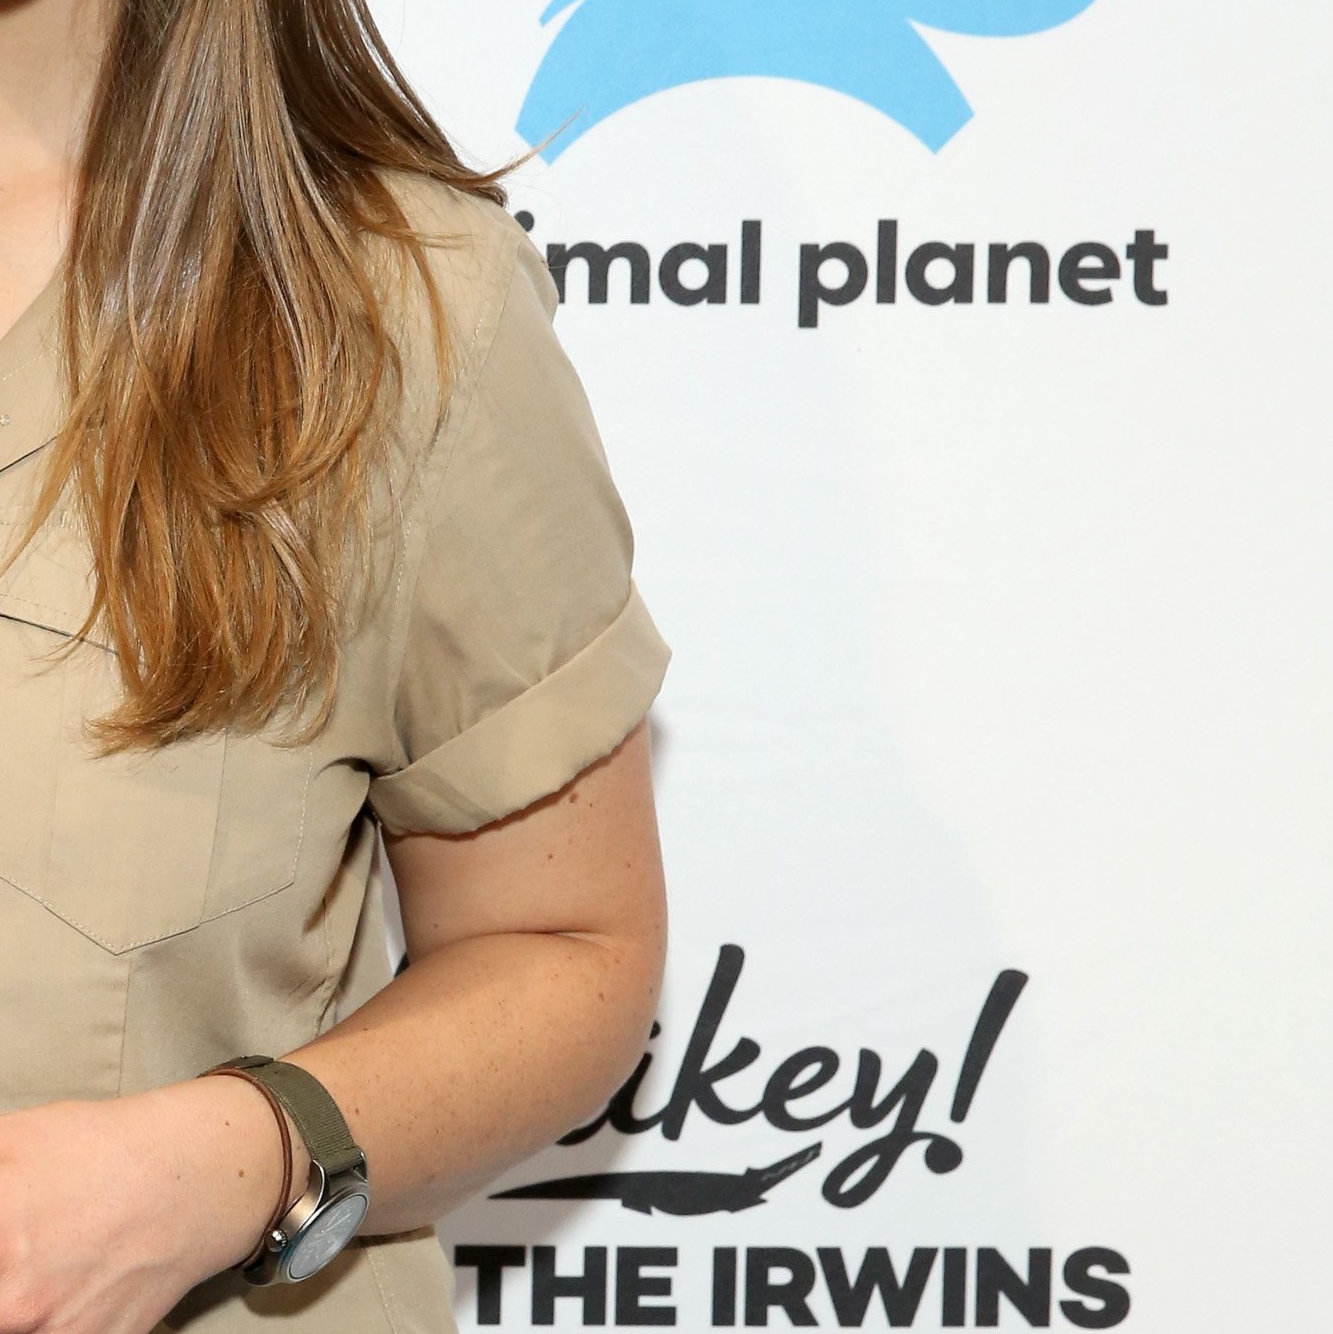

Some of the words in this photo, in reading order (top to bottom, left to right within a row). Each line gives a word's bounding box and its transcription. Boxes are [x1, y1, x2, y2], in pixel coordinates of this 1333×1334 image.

[798, 219, 1168, 328] planet
[454, 1245, 678, 1327] THE
[711, 1246, 1131, 1330] IRWINS
